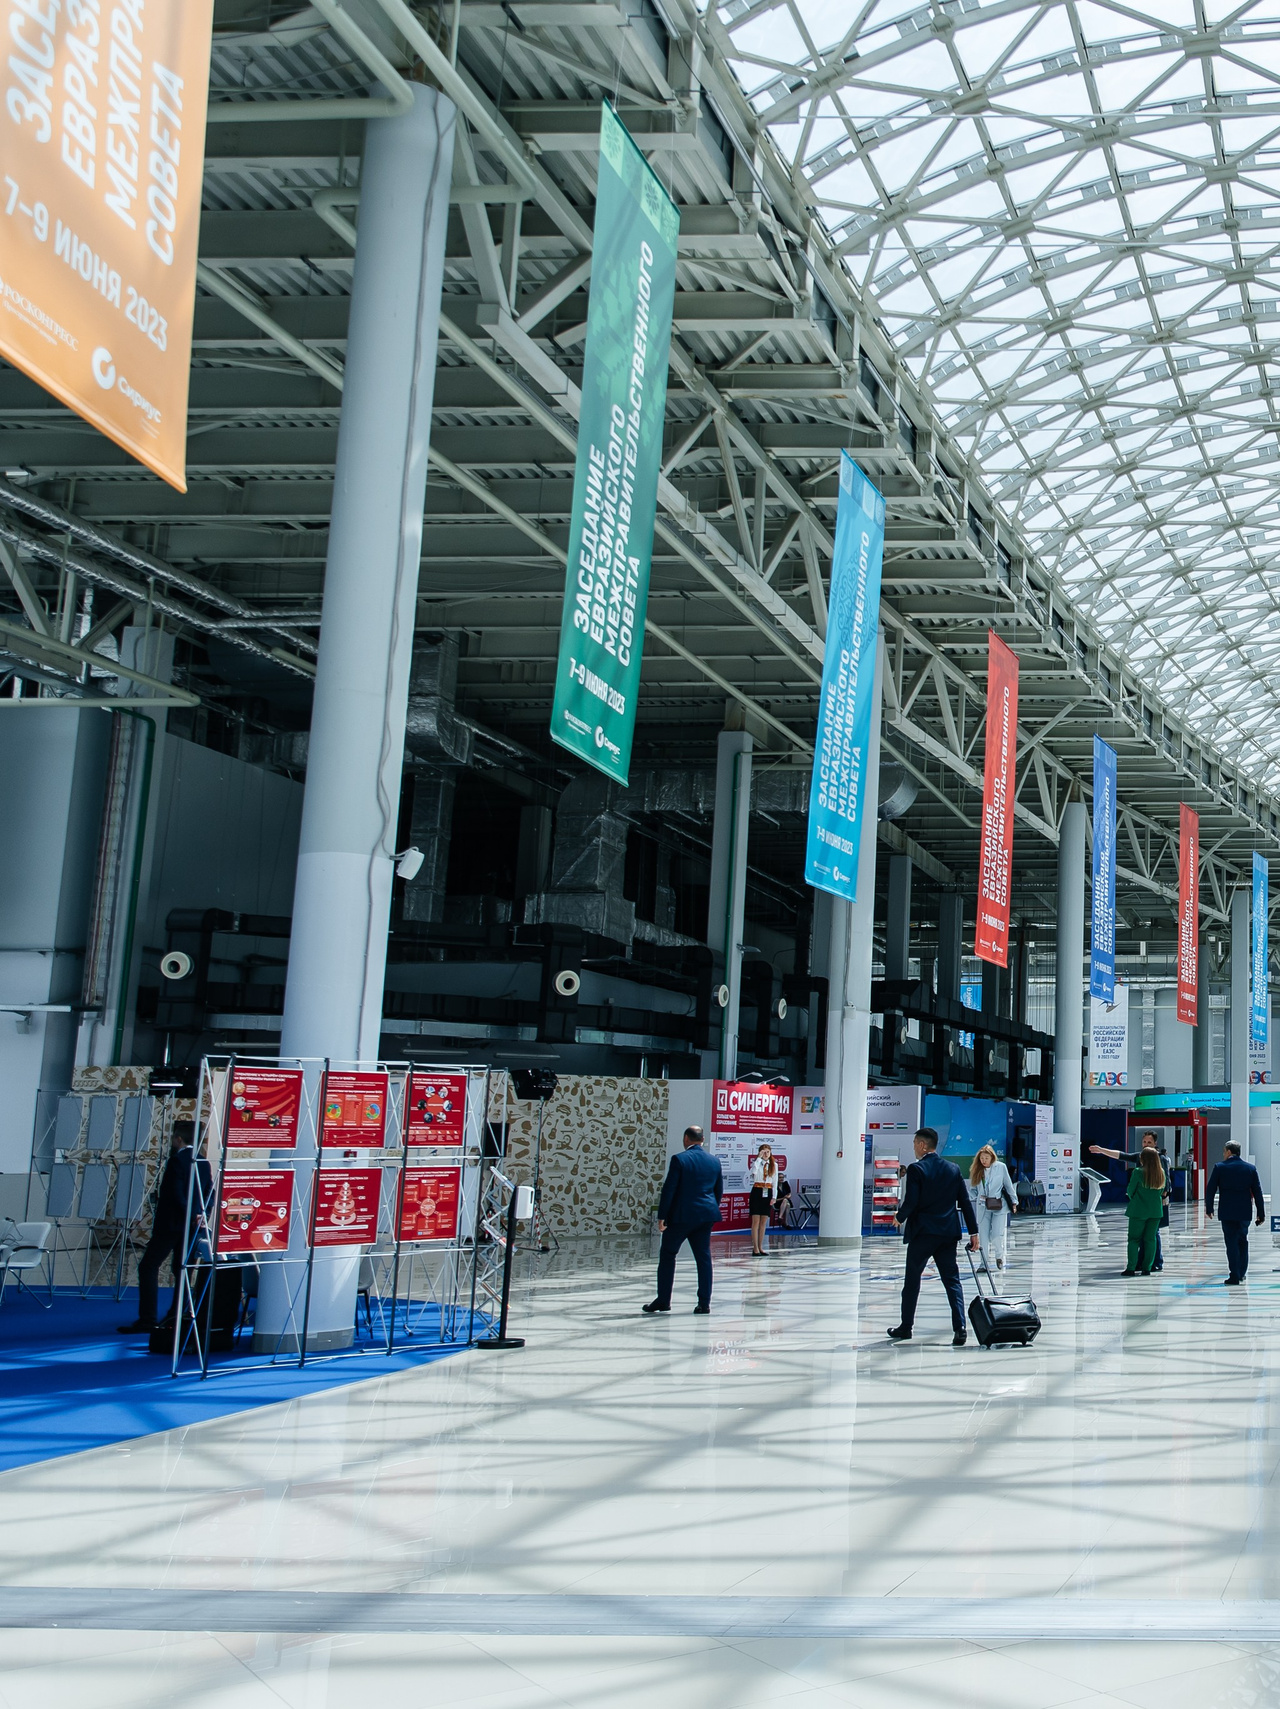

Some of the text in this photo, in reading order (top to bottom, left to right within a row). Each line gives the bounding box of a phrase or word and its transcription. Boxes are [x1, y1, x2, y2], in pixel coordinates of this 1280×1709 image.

[145, 61, 184, 266] СОВЕТА
[5, 286, 79, 352] РОСКОНГРЕСС
[54, 217, 122, 309] ИЮНЯ
[125, 285, 168, 352] 2023
[117, 376, 162, 424] Сириус
[604, 240, 654, 657] МЕЖПРАВИТЕЛЬСТВЕННОГО
[573, 444, 605, 634] ЗАСЕДАНИЕ
[590, 403, 626, 645] ЕВРАЗИЙСКОГО
[617, 555, 640, 668] СОВЕТА
[569, 657, 585, 685] 7-9
[608, 684, 625, 716] 2023
[828, 649, 849, 813] ЕВРАЗИЙСКОГО
[838, 531, 870, 818] МЕЖПРАВИТЕЛЬСТВЕННОГО
[818, 681, 837, 808] ЗАСЕДАНИЕ
[847, 747, 861, 823] СОВЕТА
[995, 686, 1010, 906] МЕЖПРАВИТЕЛЬСТВЕННОГО
[982, 803, 993, 899] ЗАСЕДАНИЕ
[989, 778, 1001, 902] ЕВРАЗИЙСКОГО
[1001, 849, 1009, 907] СОВЕТА
[729, 1091, 790, 1114] СИНЕРГИЯ
[801, 1096, 825, 1113] ЕА
[1089, 1072, 1128, 1086] ЕАЭС
